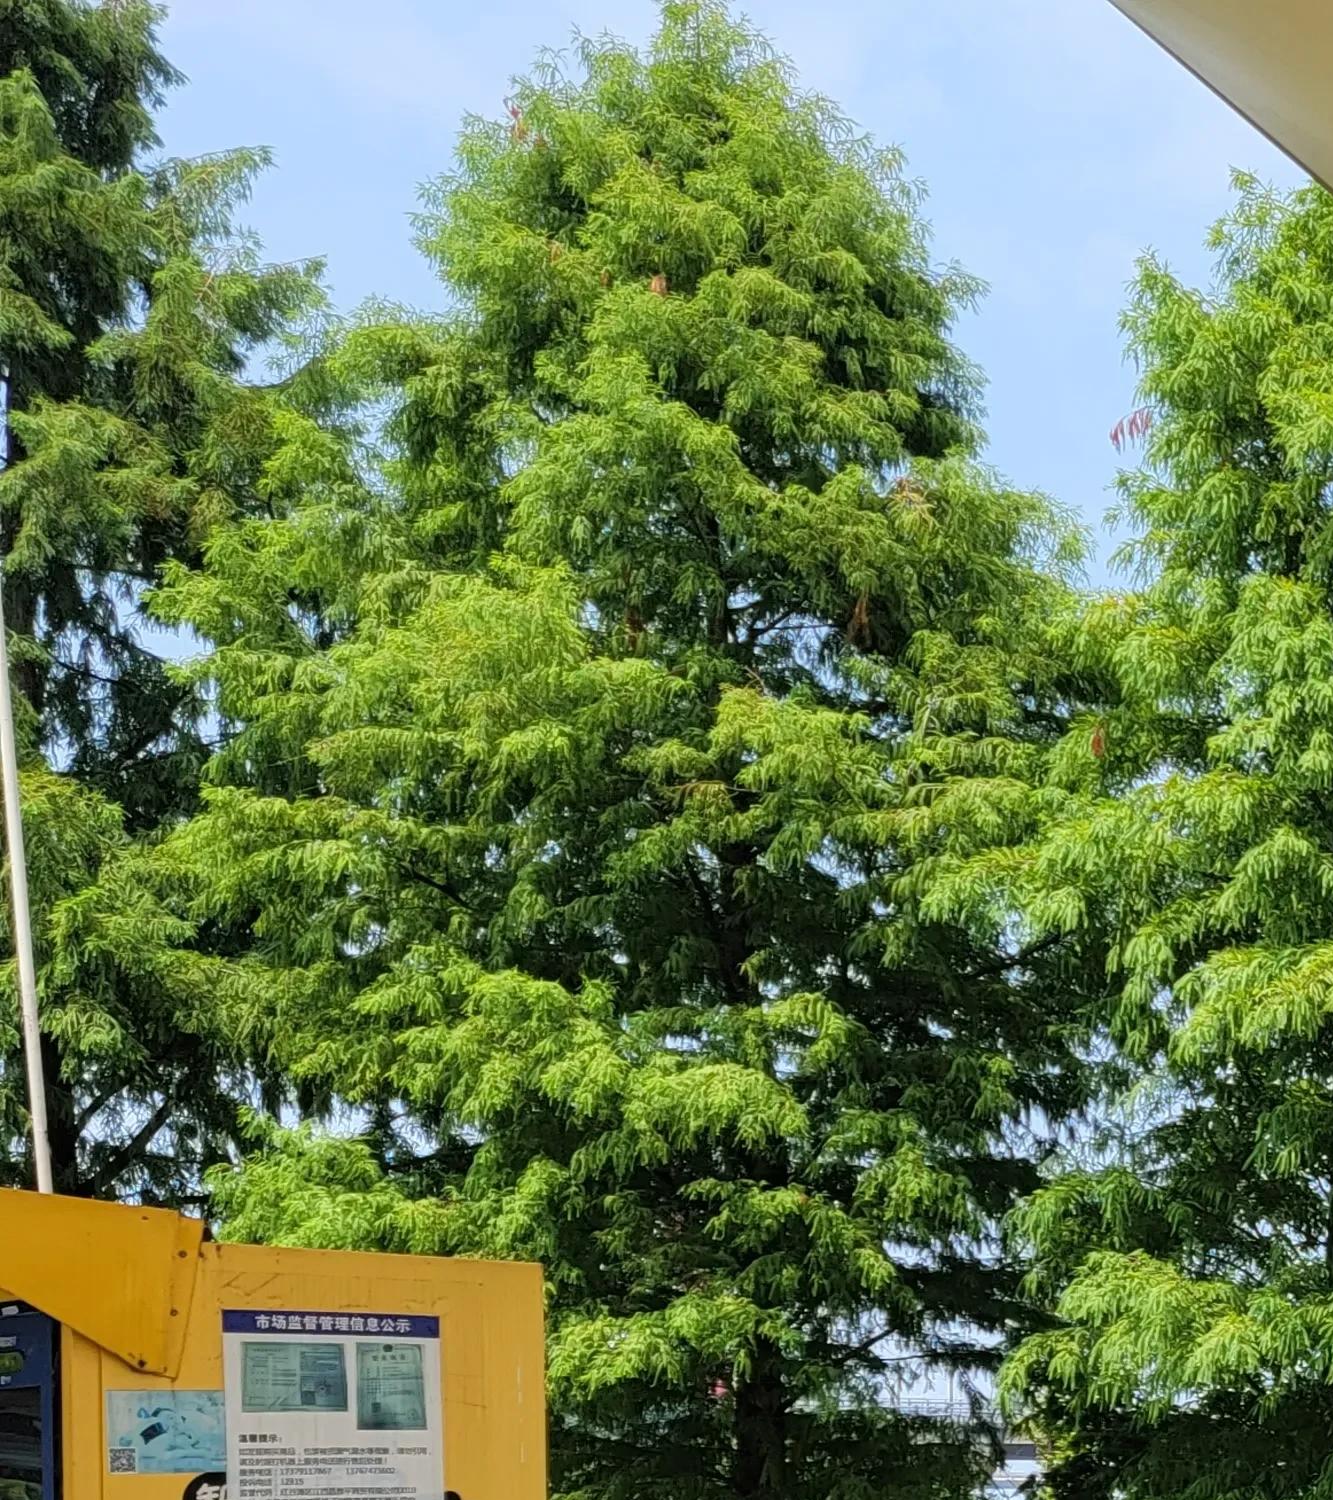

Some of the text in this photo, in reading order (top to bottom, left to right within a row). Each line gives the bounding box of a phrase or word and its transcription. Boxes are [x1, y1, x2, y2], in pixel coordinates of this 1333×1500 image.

[255, 1314, 412, 1333] 市场监督管理信息公示
